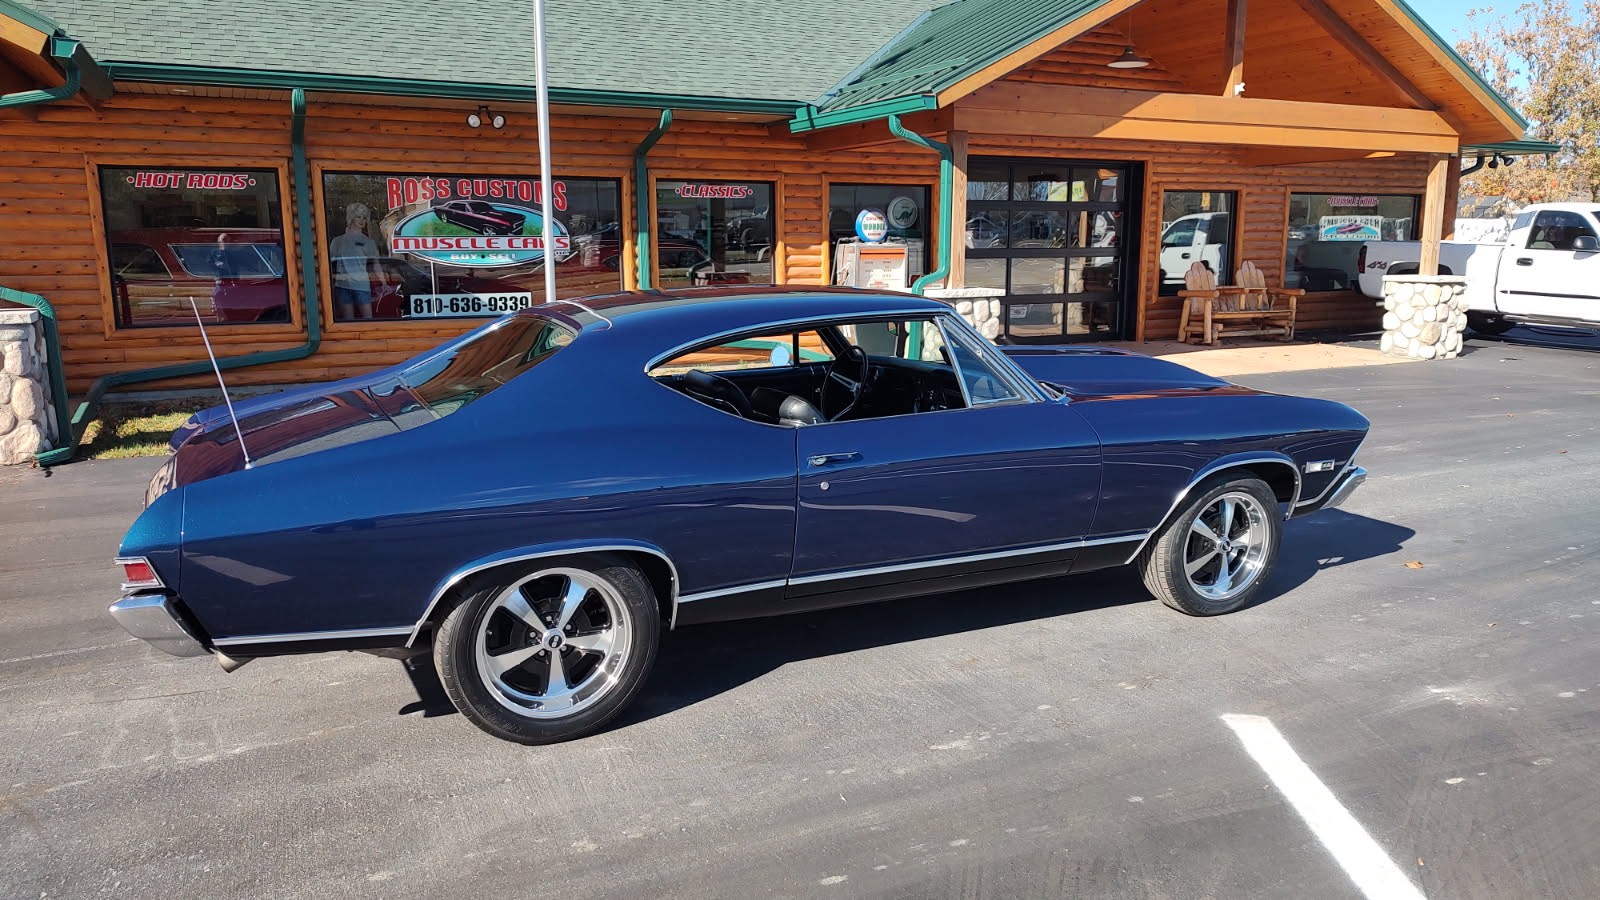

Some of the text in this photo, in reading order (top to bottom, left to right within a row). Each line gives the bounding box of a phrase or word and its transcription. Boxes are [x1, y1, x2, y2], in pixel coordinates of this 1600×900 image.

[134, 172, 249, 190] HOT RODS
[386, 177, 451, 210] ROSS
[681, 184, 748, 199] CLASSICS
[393, 237, 500, 250] MUSCLE
[413, 296, 529, 314] 810-636-9339
